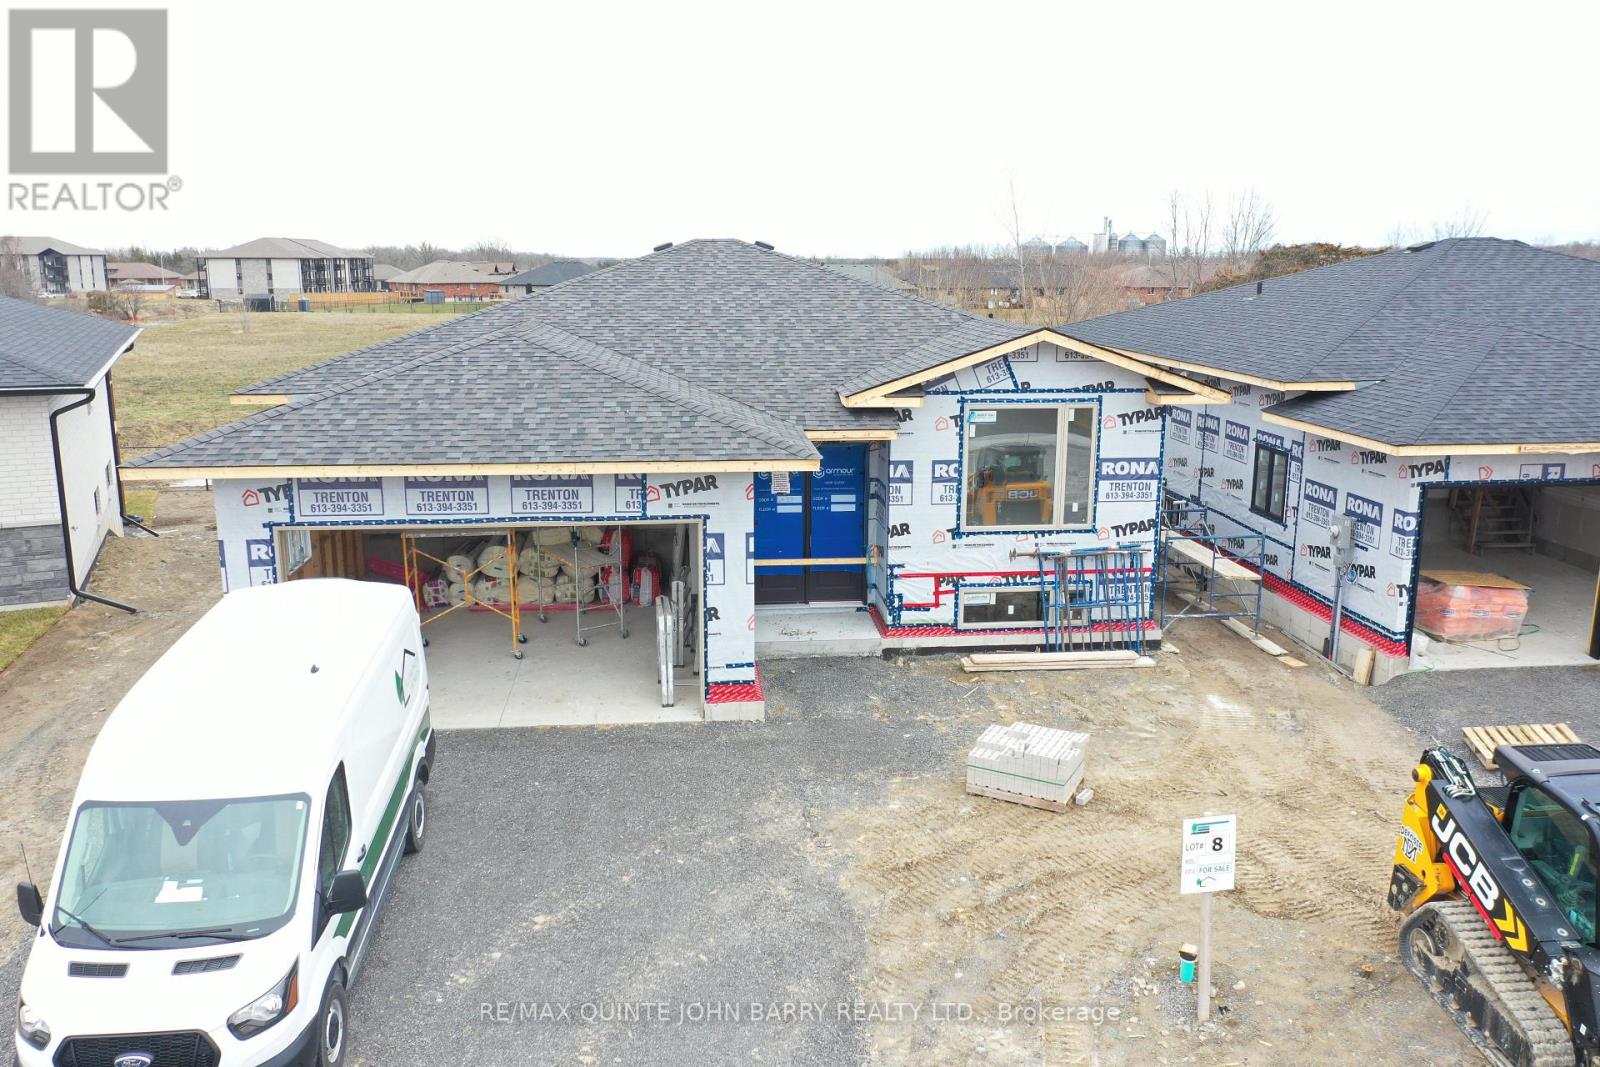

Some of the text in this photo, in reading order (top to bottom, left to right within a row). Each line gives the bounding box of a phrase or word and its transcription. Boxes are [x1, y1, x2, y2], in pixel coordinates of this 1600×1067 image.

[1102, 461, 1159, 475] RONA
[658, 474, 719, 498] TYPAR
[1109, 482, 1151, 492] TRENTON
[313, 491, 369, 503] TRENTON
[420, 490, 475, 502] TRENTON
[525, 489, 579, 501] TRENTON
[1106, 491, 1153, 501] 613-394-3351
[1305, 481, 1335, 504] RONA
[310, 503, 372, 513] 613-394-3351
[416, 502, 477, 512] 613-394-3351
[522, 500, 582, 510] 613-394-3351
[1346, 497, 1380, 521] RONA
[1307, 545, 1331, 559] TYPAR
[1212, 837, 1223, 851] 8
[1431, 814, 1499, 911] JCB
[1199, 866, 1212, 874] FOR
[1214, 864, 1230, 873] SALE
